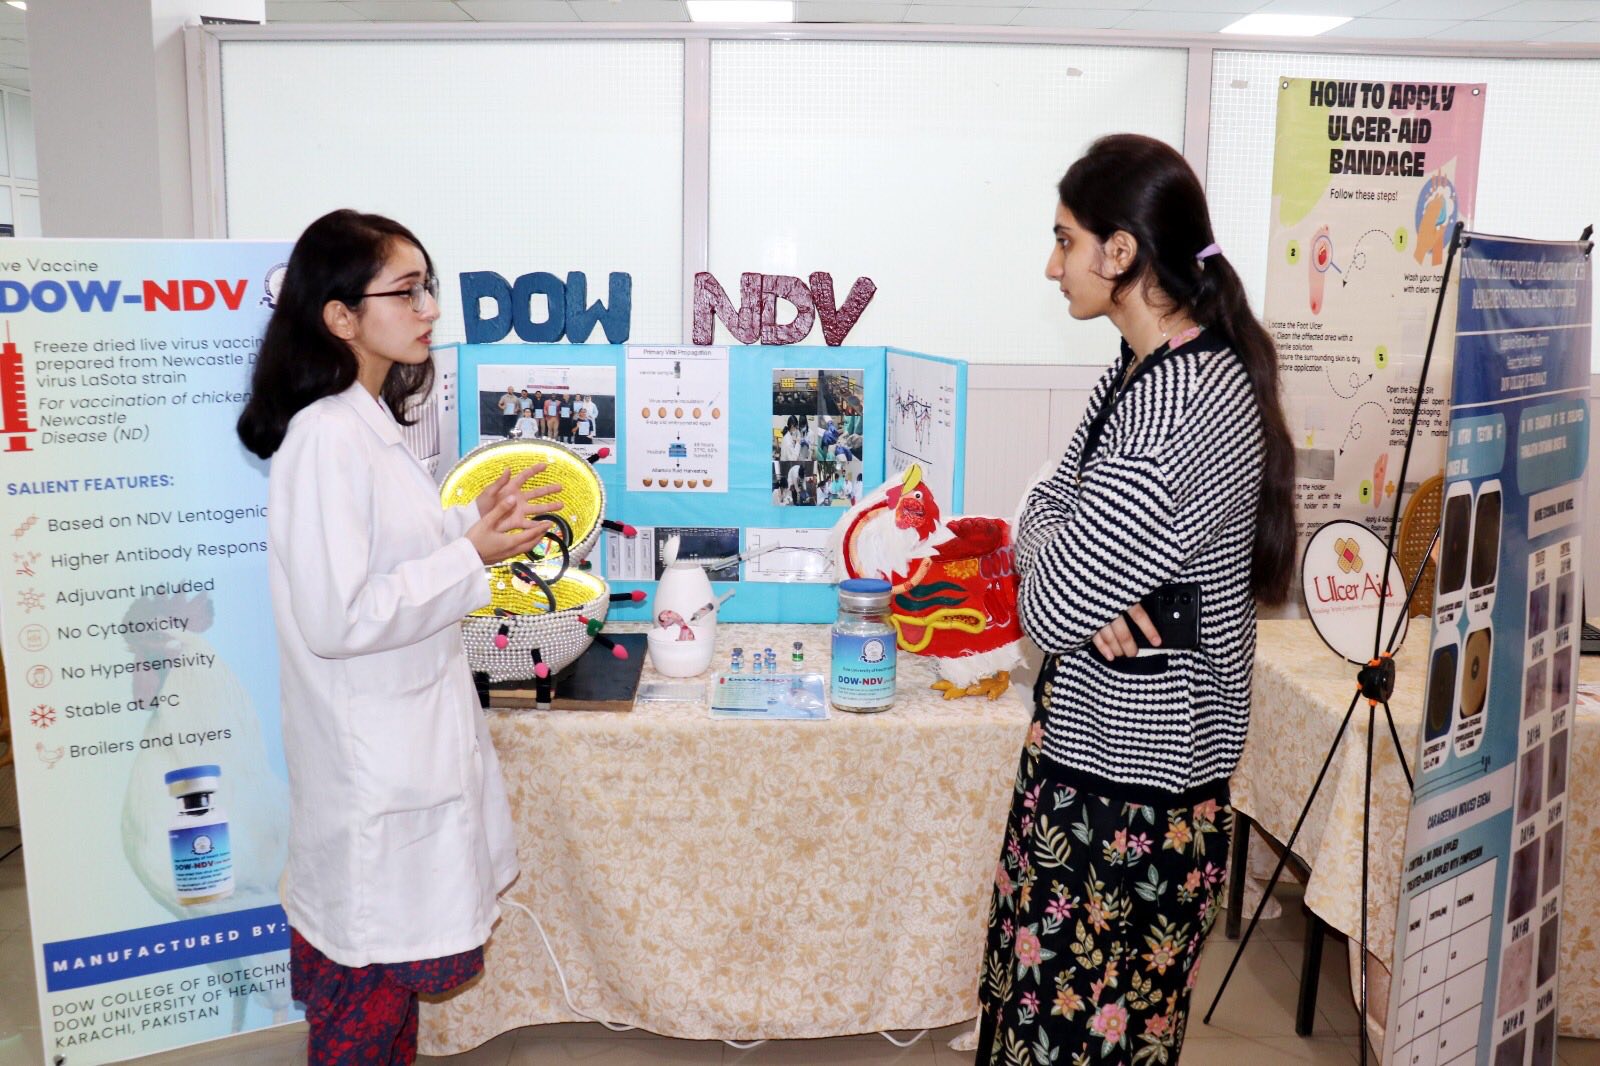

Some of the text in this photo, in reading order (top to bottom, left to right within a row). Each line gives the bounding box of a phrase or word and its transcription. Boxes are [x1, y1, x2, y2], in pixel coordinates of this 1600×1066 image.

[1309, 81, 1456, 111] HOW TO APPLY
[1328, 115, 1432, 144] ULCER-AID
[1329, 149, 1425, 177] BANDAGE
[1330, 188, 1398, 203] Follow these steps!
[0, 257, 98, 272] ve Vaccine
[1433, 274, 1443, 282] han
[0, 279, 248, 313] DOW-NDV
[459, 271, 632, 345] DOW
[692, 271, 877, 347] NDV
[1269, 321, 1323, 330] Locate the Foot Ulcer
[1277, 332, 1291, 340] Clean
[1292, 332, 1300, 340] the
[1302, 333, 1323, 341] affected
[34, 336, 264, 353] Freeze dried live virus vaccin
[643, 349, 663, 358] Primary
[678, 349, 712, 357] Propagation
[36, 357, 114, 374] prepared
[119, 357, 157, 369] from
[163, 353, 243, 367] Newcastle
[1304, 354, 1334, 363] surrounding
[38, 372, 187, 388] virus LaSota strain
[1387, 385, 1399, 394] Open
[39, 397, 65, 410] For
[70, 395, 166, 409] vaccination
[172, 392, 187, 405] of
[40, 412, 127, 427] Newcastle
[41, 424, 150, 444] Disease (ND)
[7, 475, 174, 495] SALIENT FEATURES:
[48, 504, 268, 531] Based on NDV Lentogenic
[51, 540, 268, 570] Higher Antibody Respons
[55, 578, 215, 606] Adjuvant Included
[1314, 575, 1359, 602] Ulcer
[58, 616, 189, 640] No Cytotoxicity
[61, 653, 216, 680] No Hypersensivity
[838, 676, 883, 685] DOW-NDV
[65, 701, 121, 718] Stable
[127, 699, 145, 711] at
[70, 728, 232, 758] Broilers and Layers
[53, 923, 286, 972] MANUFACTURED BY:
[52, 961, 294, 1017] DOW COLLEGE OF BIOTECHNO
[54, 978, 285, 1033] DOW UNIVERSITY OF HEALTH
[55, 1006, 220, 1049] KARACHI, PAKISTAN
